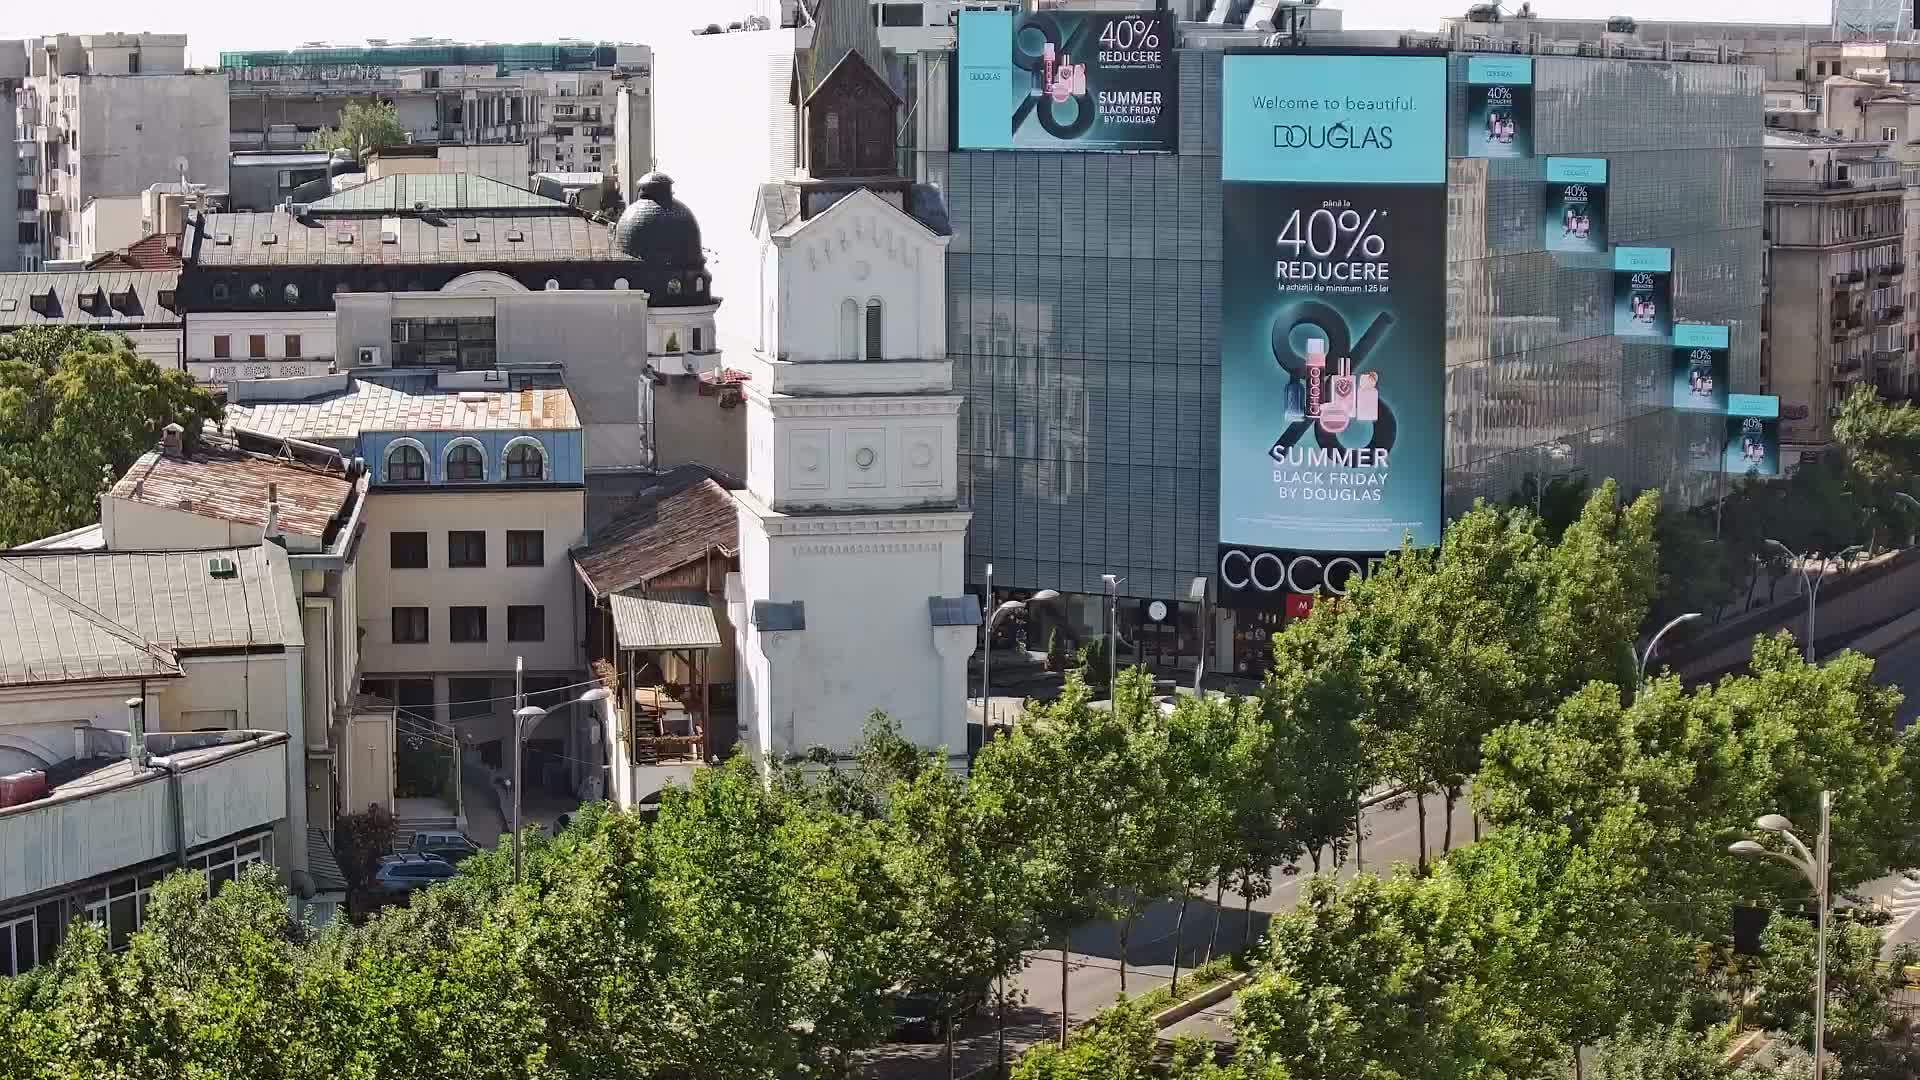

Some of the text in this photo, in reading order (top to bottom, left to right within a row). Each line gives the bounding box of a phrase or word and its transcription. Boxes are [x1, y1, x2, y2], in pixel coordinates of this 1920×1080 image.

[1099, 51, 1161, 62] REDUCERE
[1099, 91, 1162, 104] SUMMER
[1253, 96, 1418, 110] Welcome to beautiful.
[1099, 106, 1162, 115] BLACK FRIDAY
[1273, 122, 1393, 150] DOUGLAS
[1277, 261, 1390, 280] REDUCERE
[1278, 282, 1285, 291] la
[1314, 284, 1325, 292] de
[1326, 284, 1362, 293] minimum
[1365, 284, 1378, 293] 125
[1309, 366, 1321, 416] CHOCO
[1273, 445, 1389, 468] SUMMER
[1273, 470, 1389, 486] BLACK FRIDAY
[1279, 486, 1382, 501] BY DOUGLAS
